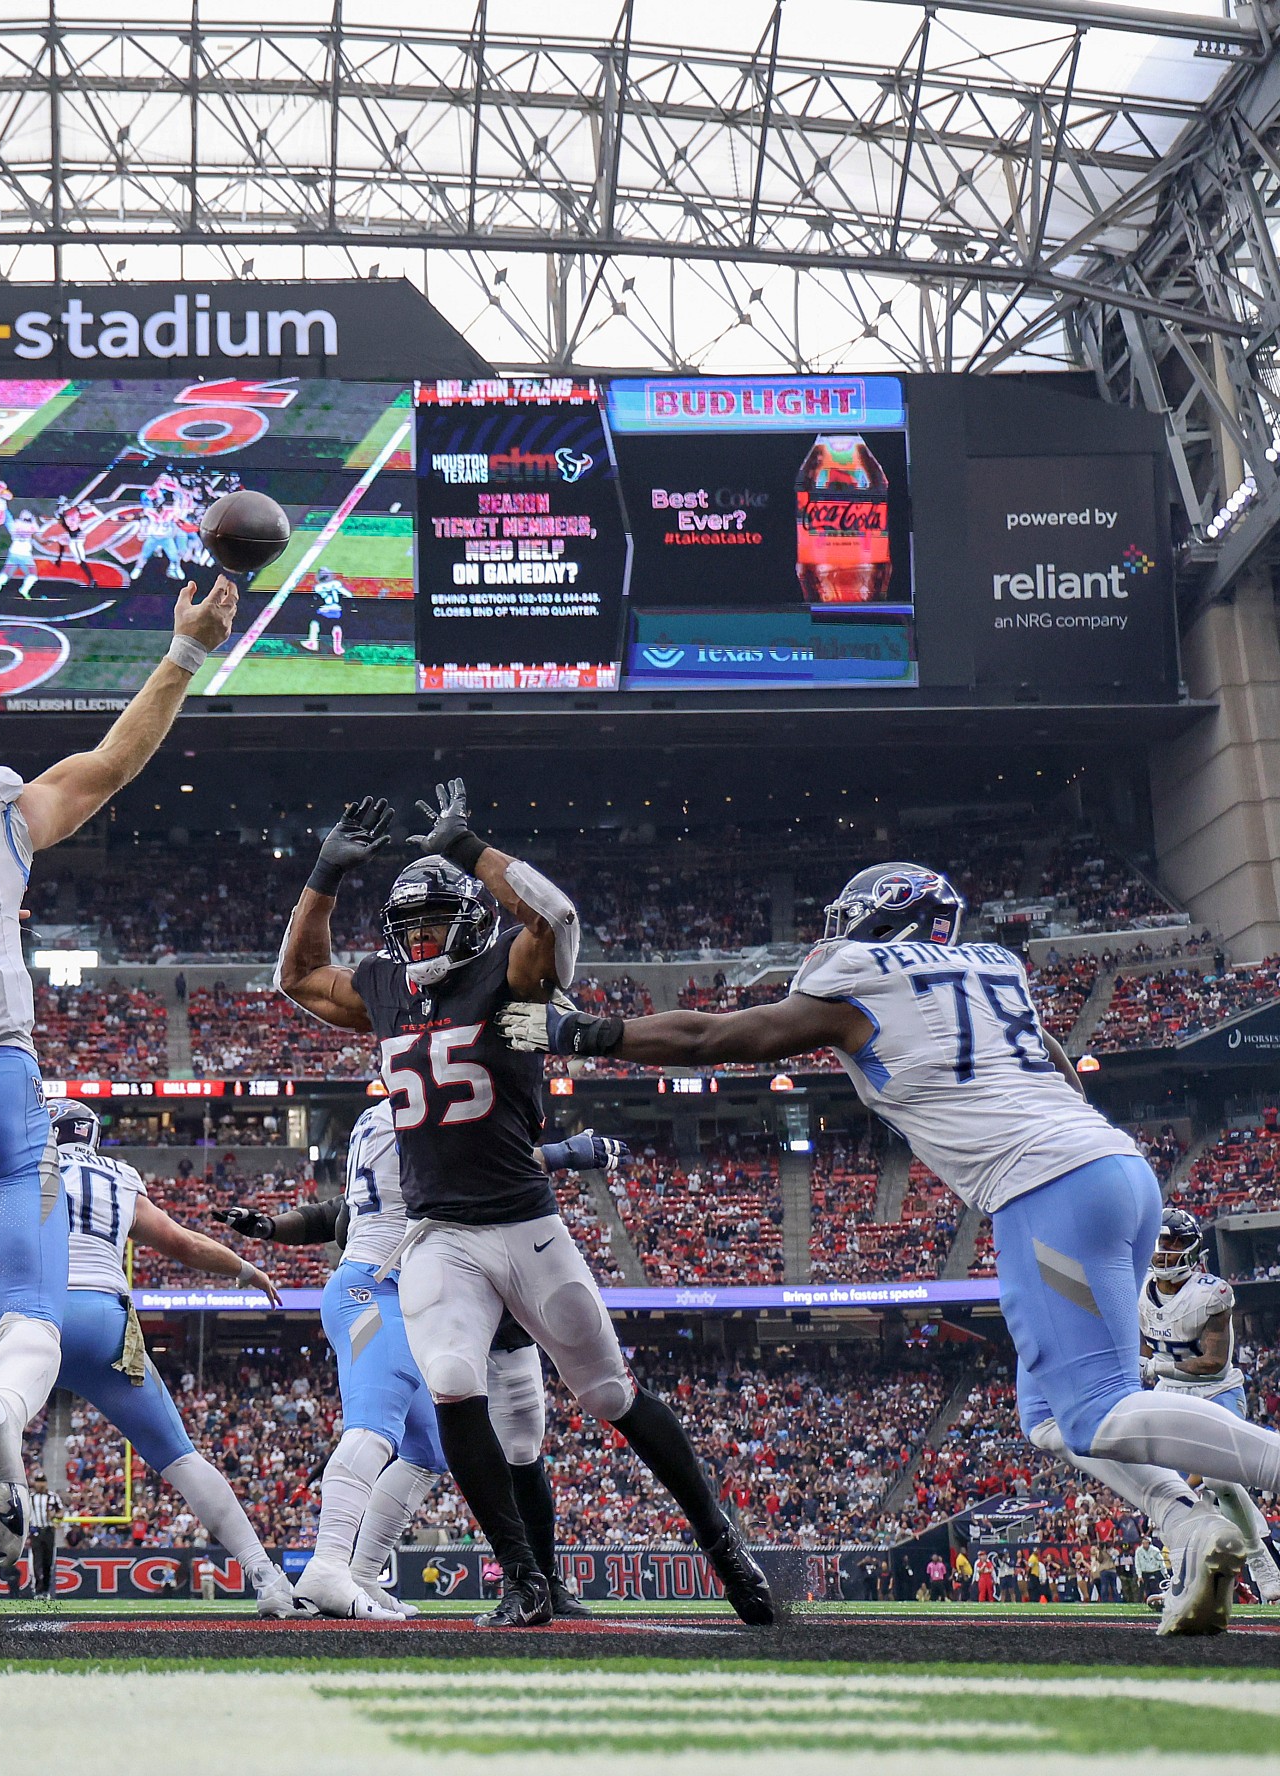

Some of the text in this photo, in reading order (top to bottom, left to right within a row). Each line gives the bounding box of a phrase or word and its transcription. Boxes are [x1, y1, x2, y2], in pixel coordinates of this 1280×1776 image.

[14, 294, 338, 359] stadium
[512, 378, 572, 397] TEXANS
[655, 388, 856, 416] BUD LIGHT
[432, 454, 488, 470] HOUSTON
[443, 468, 488, 484] TEXANS
[478, 493, 550, 514] SEASON
[652, 488, 709, 508] Best
[432, 516, 597, 540] TICKET MEMBERS,
[678, 510, 747, 532] Ever?
[1006, 508, 1118, 530] powered by
[664, 532, 763, 545] #takeataste
[465, 540, 565, 561] NEED HELP
[453, 562, 578, 585] ON GAMEDAY?
[993, 564, 1129, 600] reliant
[431, 593, 468, 605] BEHIND
[469, 593, 517, 604] SECTIONS
[433, 606, 471, 618] CLOSES
[472, 606, 493, 617] END
[494, 606, 508, 617] OF
[509, 606, 529, 617] THE
[551, 605, 600, 617] QUARTER.
[994, 613, 1128, 630] an NRG company
[692, 636, 763, 663] Texas
[443, 671, 517, 688] HOUSTON
[519, 670, 581, 688] TEXANS
[6, 699, 73, 711] MITSUBISHI
[401, 1018, 453, 1031] TEXANS
[909, 970, 1056, 1084] 78
[381, 1019, 495, 1131] 55
[142, 1294, 171, 1309] Bring
[172, 1296, 186, 1306] on
[188, 1293, 206, 1306] the
[207, 1294, 244, 1306] fastest
[783, 1286, 928, 1305] Bring on the fastest speeds
[796, 1324, 841, 1332] TEAM SHOP
[1150, 1327, 1172, 1337] TITANS
